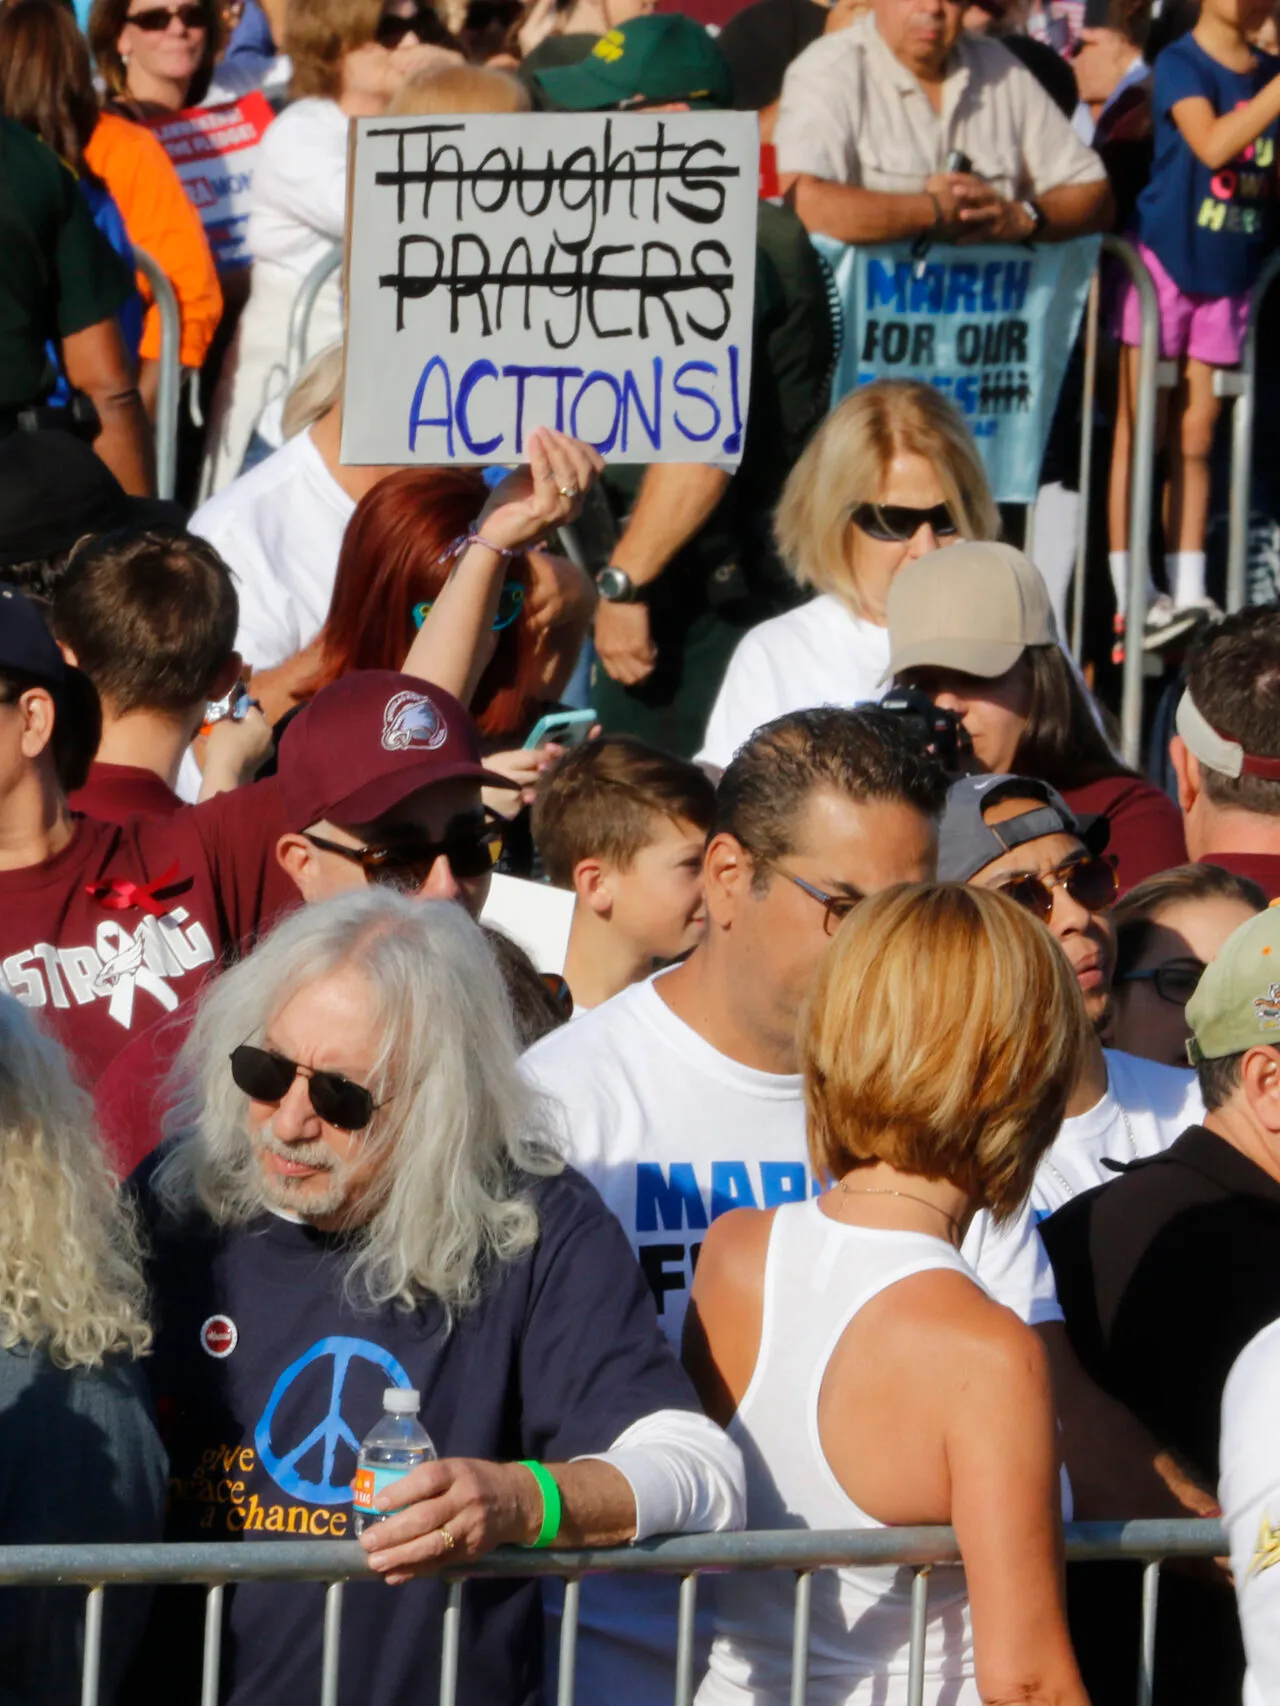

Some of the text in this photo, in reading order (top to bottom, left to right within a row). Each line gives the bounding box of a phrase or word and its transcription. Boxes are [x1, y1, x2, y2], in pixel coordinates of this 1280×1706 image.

[866, 258, 1032, 315] MARCH
[861, 318, 1030, 367] FOR OUR
[226, 1493, 348, 1537] chance
